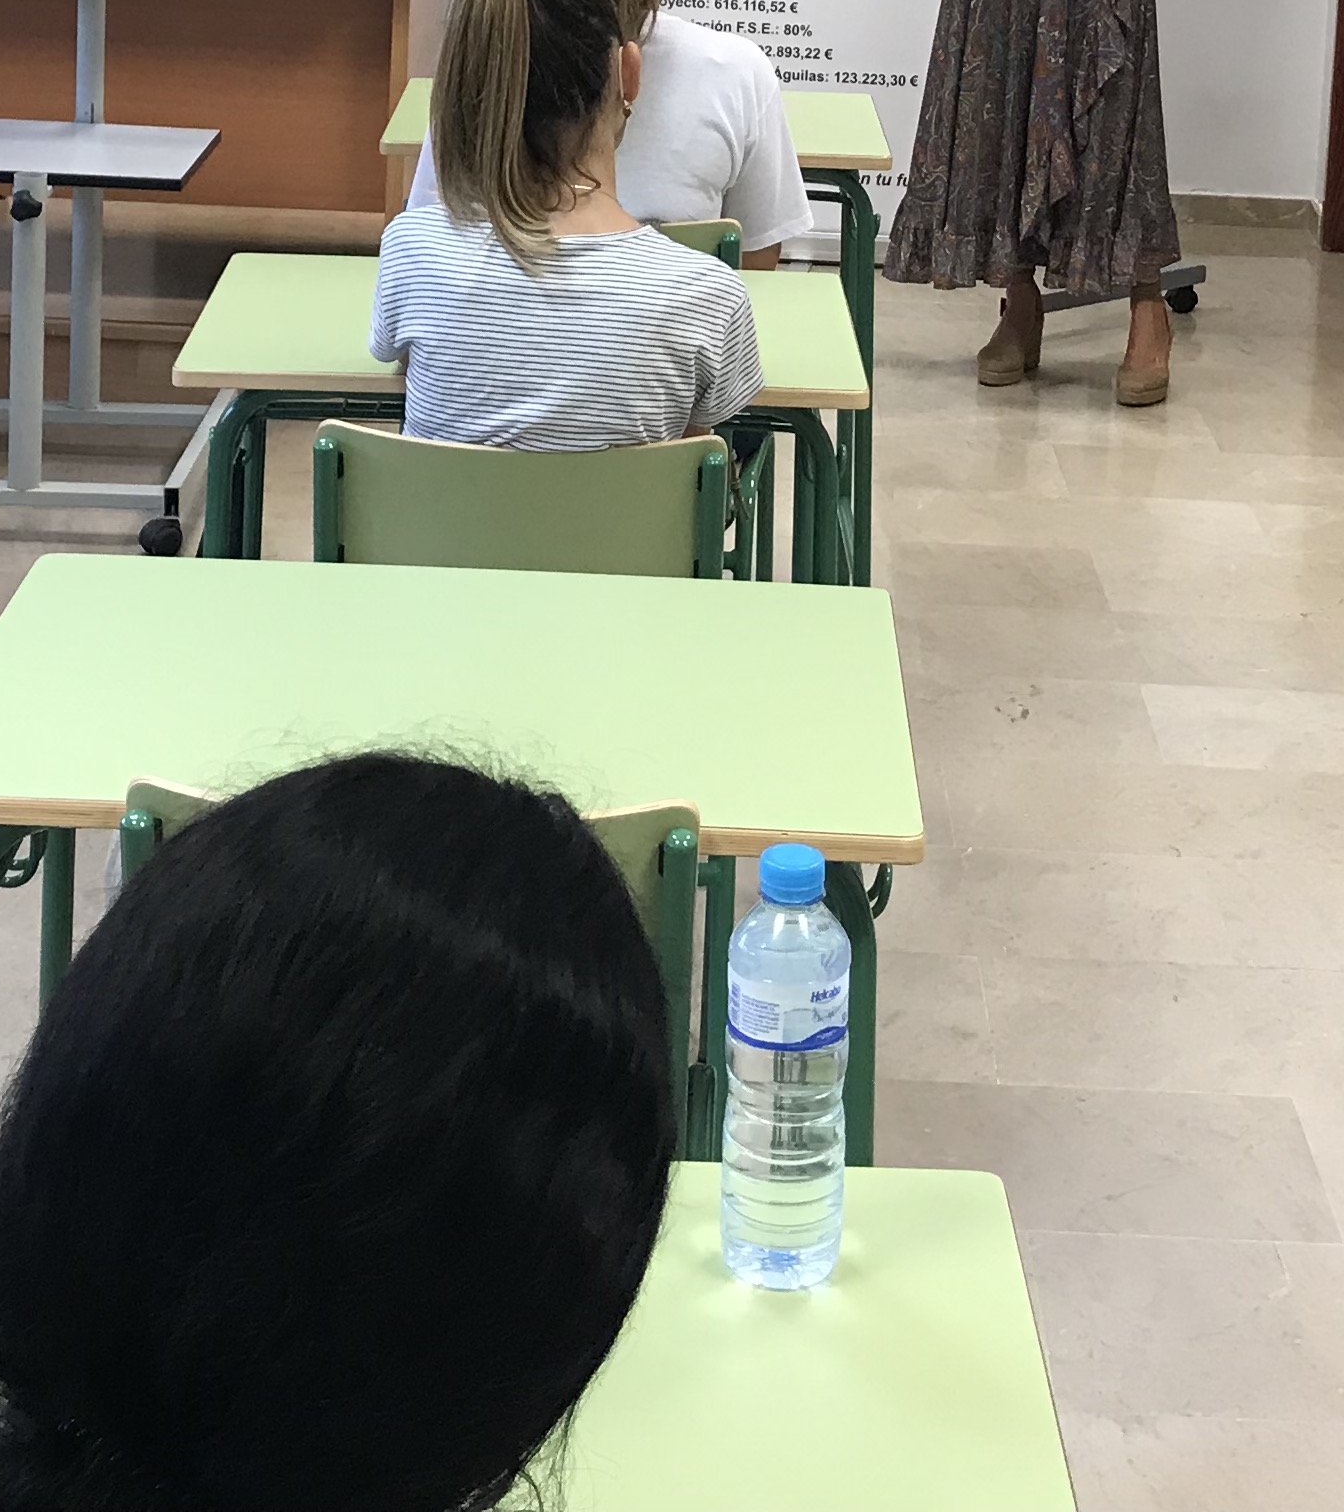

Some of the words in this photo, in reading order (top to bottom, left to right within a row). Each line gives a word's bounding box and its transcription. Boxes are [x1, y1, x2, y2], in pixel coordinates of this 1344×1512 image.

[789, 1, 799, 13] €
[736, 21, 779, 34] F.S.E.:
[783, 24, 813, 37] 80%
[758, 45, 821, 60] 2.893,22
[824, 48, 833, 60] €
[774, 65, 830, 84] Águilas:
[834, 71, 906, 87] 123.223,30
[910, 75, 919, 86] €
[876, 173, 892, 186] tu
